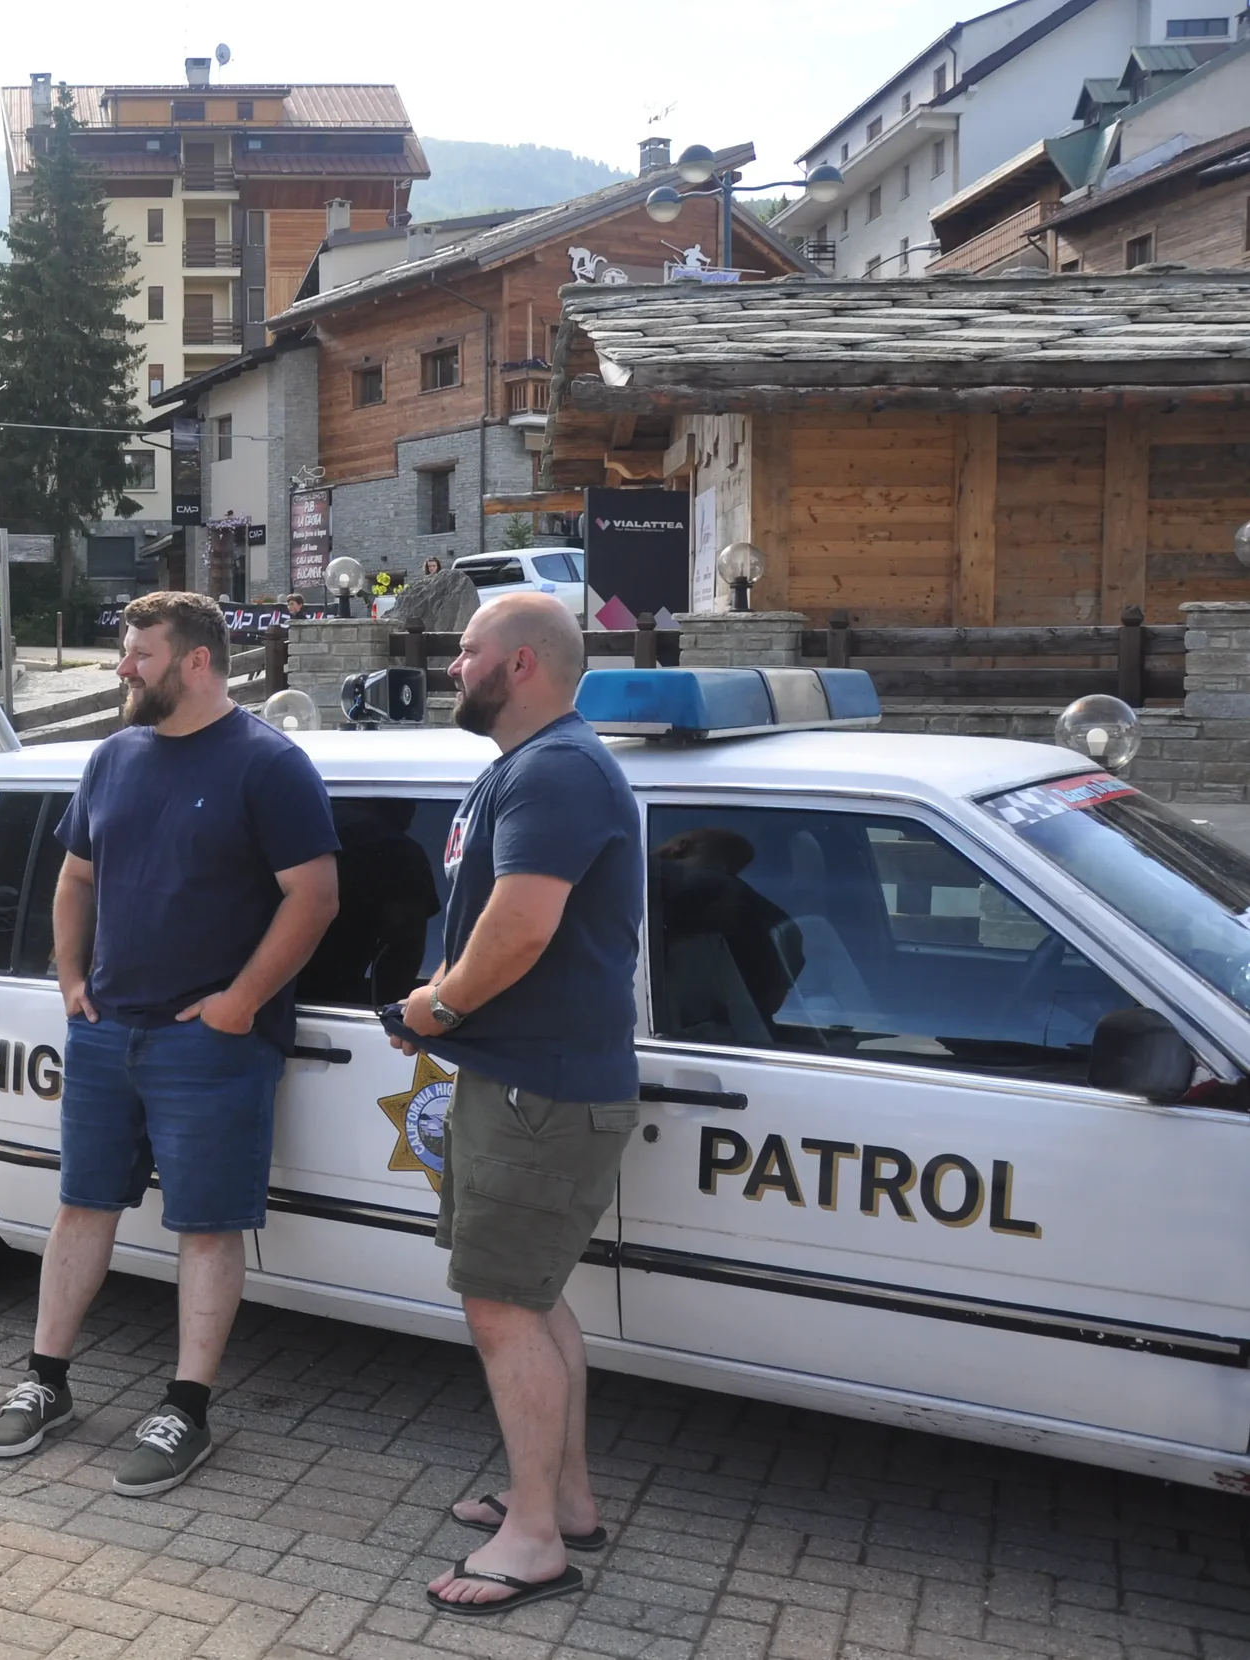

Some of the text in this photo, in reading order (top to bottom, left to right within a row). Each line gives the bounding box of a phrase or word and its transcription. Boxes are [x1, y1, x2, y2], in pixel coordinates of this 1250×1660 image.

[249, 529, 263, 538] CMP
[613, 520, 684, 529] VIALATTEA
[406, 1086, 435, 1156] CALIFORNIA
[698, 1126, 1042, 1239] PATROL
